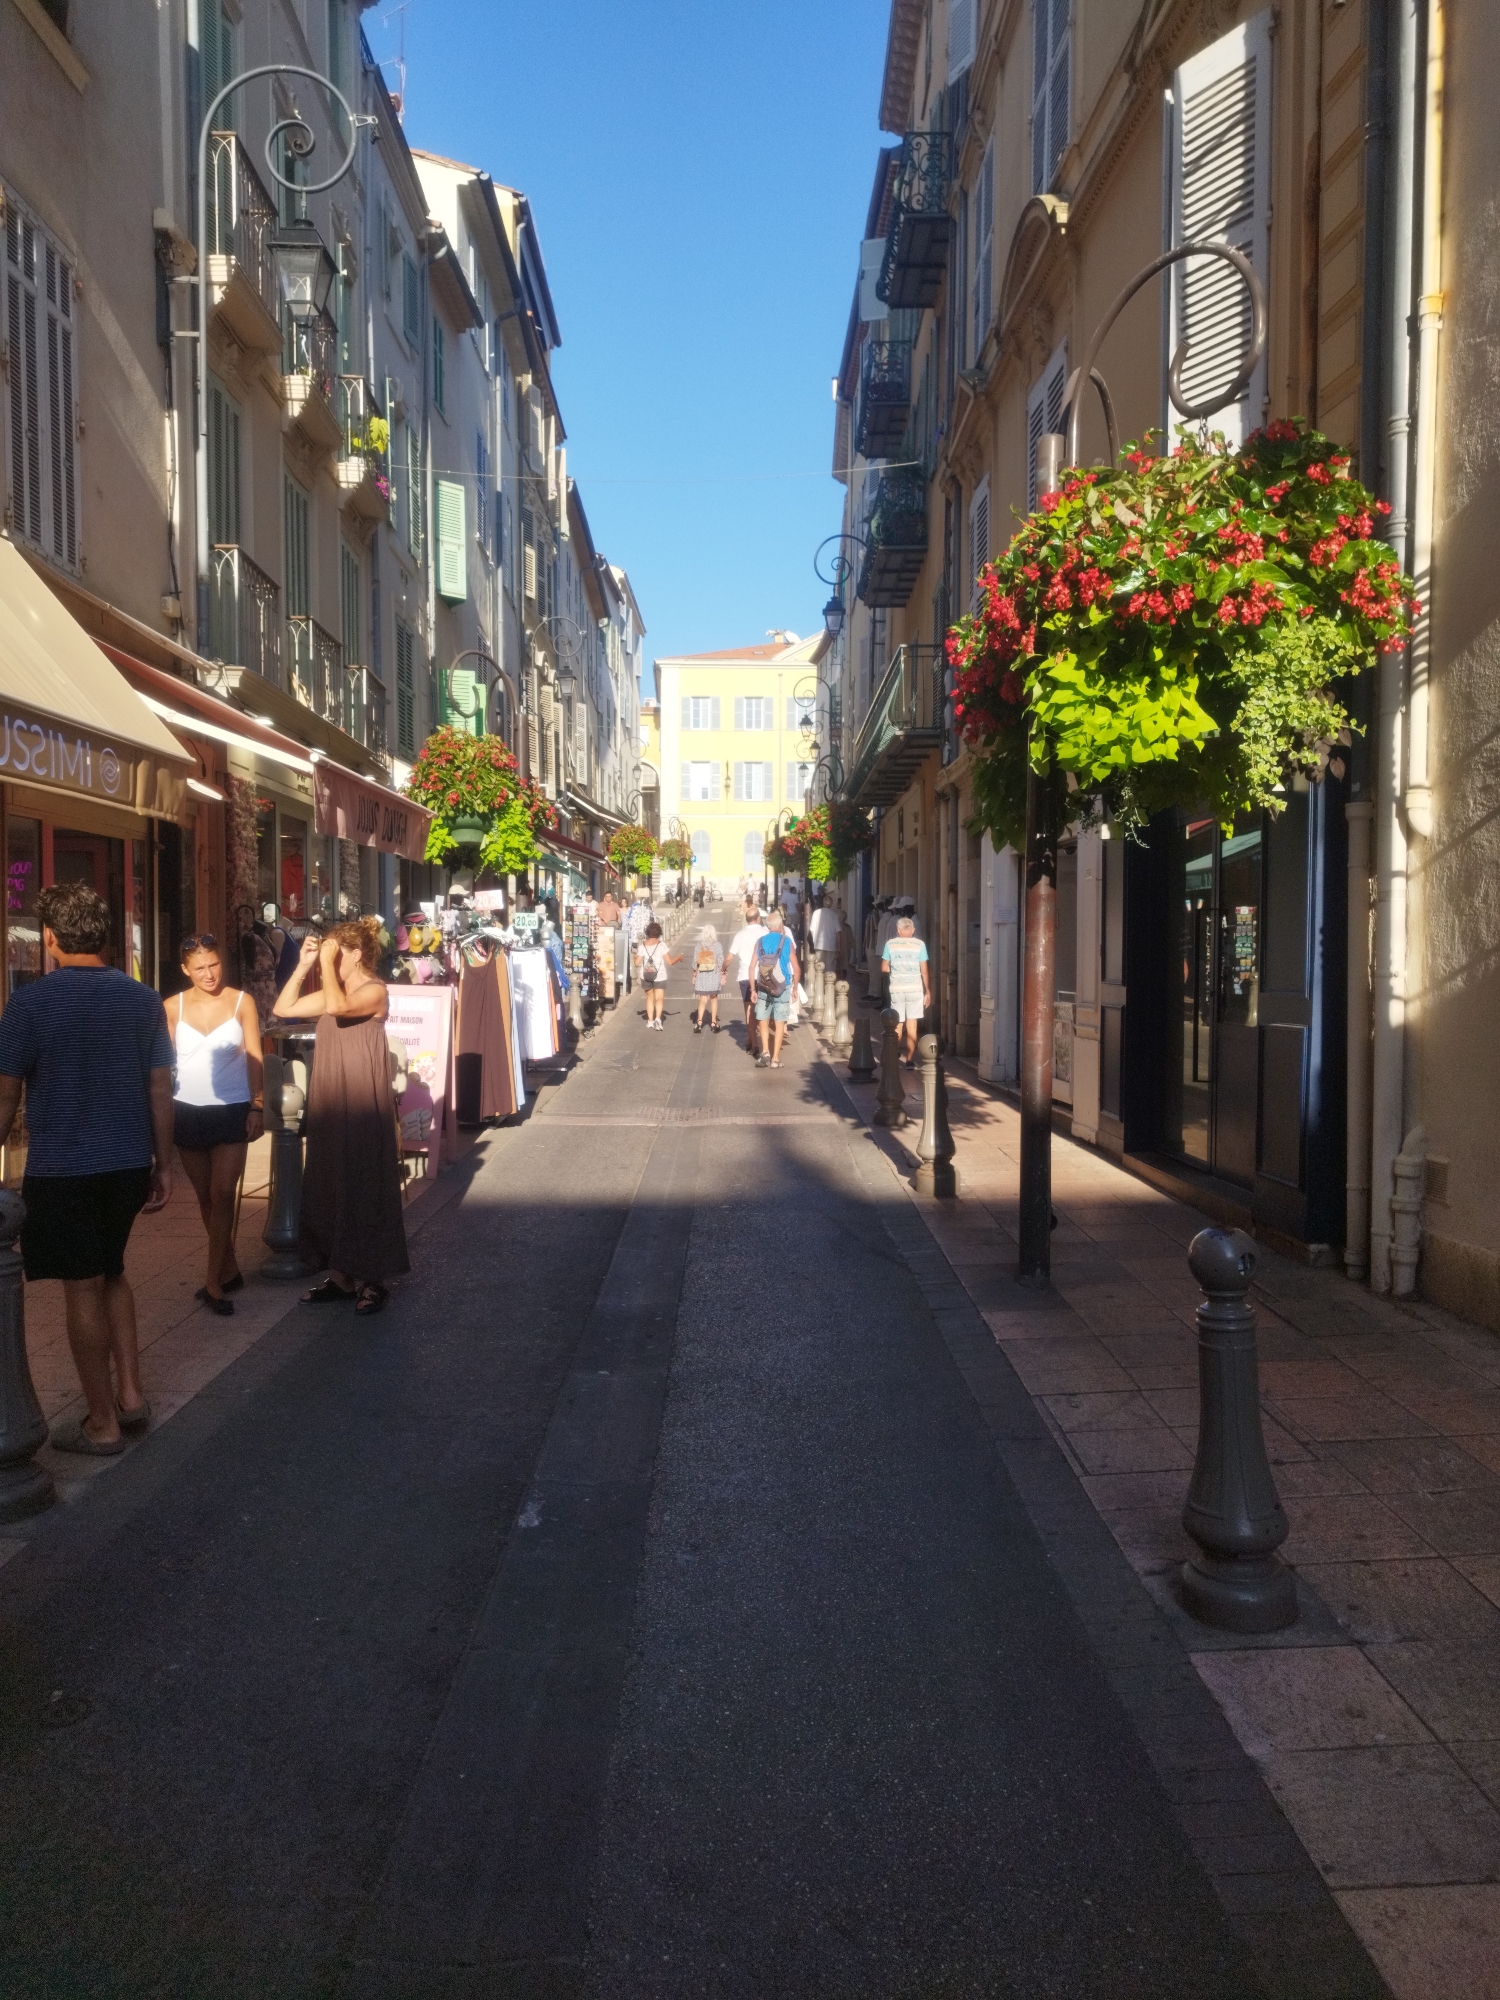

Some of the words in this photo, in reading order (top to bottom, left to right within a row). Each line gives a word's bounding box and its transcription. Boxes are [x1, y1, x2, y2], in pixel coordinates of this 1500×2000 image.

[516, 915, 537, 927] 20,00
[398, 997, 434, 1012] DOUGH
[400, 1016, 424, 1025] MAISON
[397, 1036, 420, 1046] CIALITÉ
